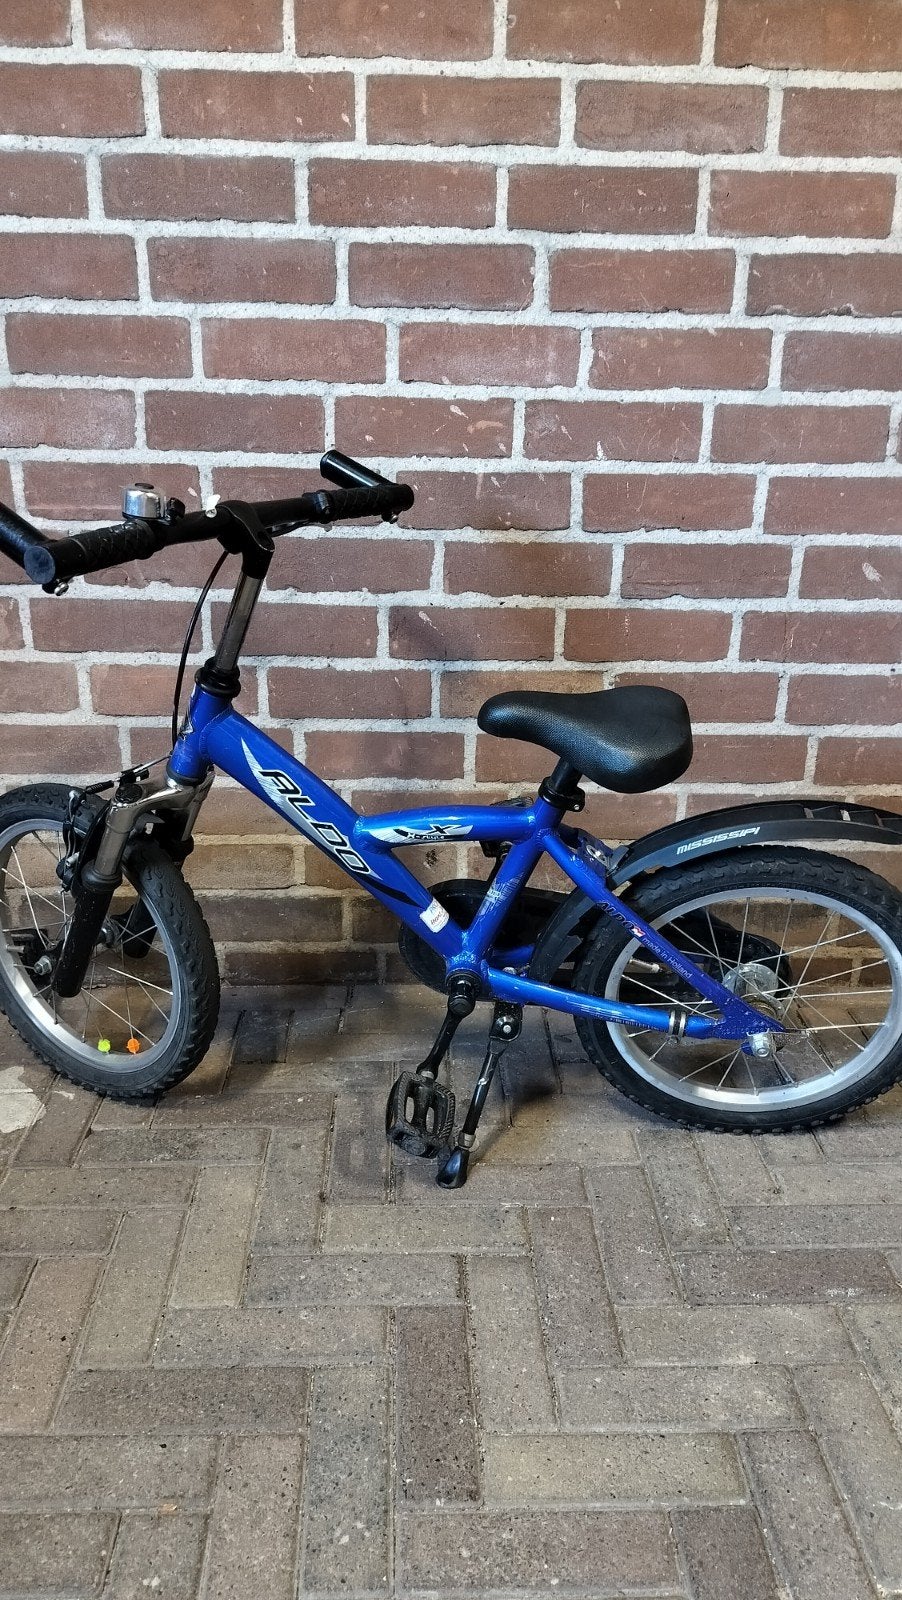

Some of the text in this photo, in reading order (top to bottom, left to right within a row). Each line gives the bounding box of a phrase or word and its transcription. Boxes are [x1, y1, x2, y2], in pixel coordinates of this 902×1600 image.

[258, 769, 371, 875] ALDO
[676, 826, 760, 855] MISSISSIPI
[596, 900, 636, 932] ALDO
[641, 937, 661, 954] made
[667, 956, 693, 979] Holland
